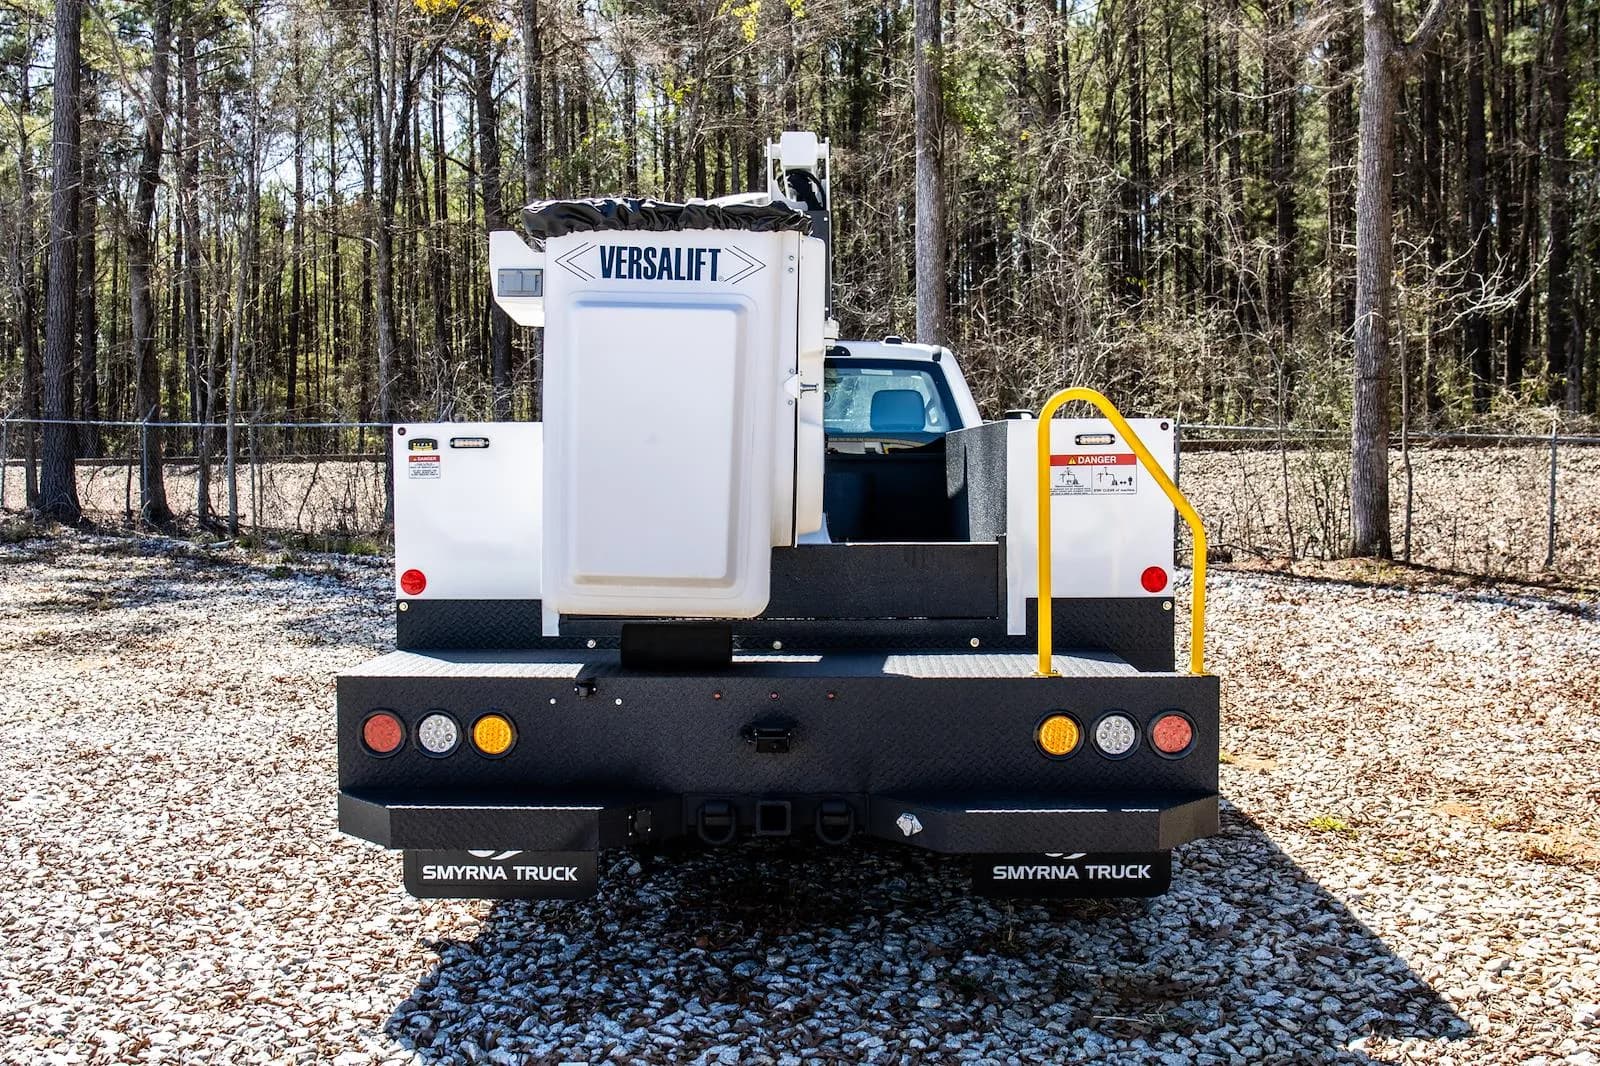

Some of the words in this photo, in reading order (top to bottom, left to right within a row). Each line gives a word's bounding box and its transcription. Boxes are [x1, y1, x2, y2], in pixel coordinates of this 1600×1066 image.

[600, 245, 721, 282] VERSALIFT
[1077, 455, 1117, 464] DANGER
[422, 865, 508, 880] SMYRNA
[512, 866, 578, 881] TRUCK
[992, 865, 1079, 880] SMYRNA
[1085, 864, 1151, 879] TRUCK
